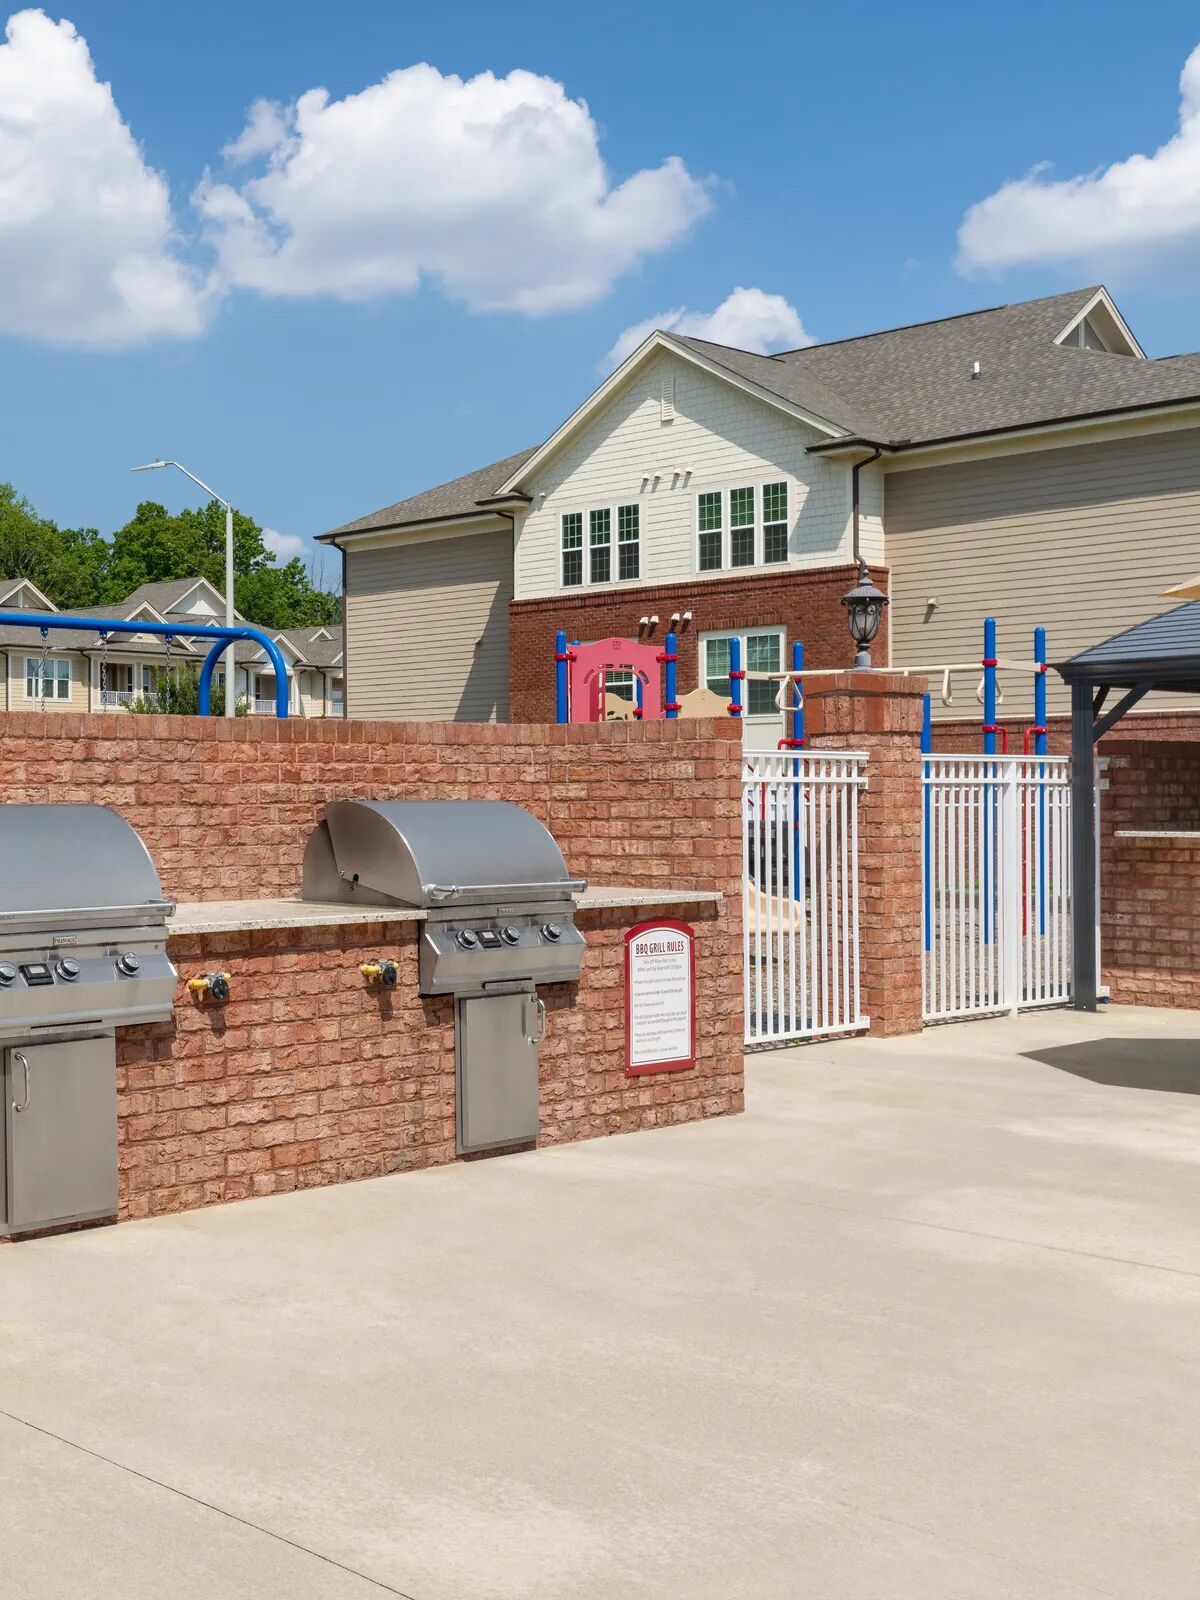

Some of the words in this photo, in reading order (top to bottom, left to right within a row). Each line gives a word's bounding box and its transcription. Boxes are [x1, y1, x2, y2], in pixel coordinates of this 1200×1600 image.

[636, 943, 648, 954] BBQ
[649, 942, 666, 953] GRILL
[667, 941, 684, 952] RULES
